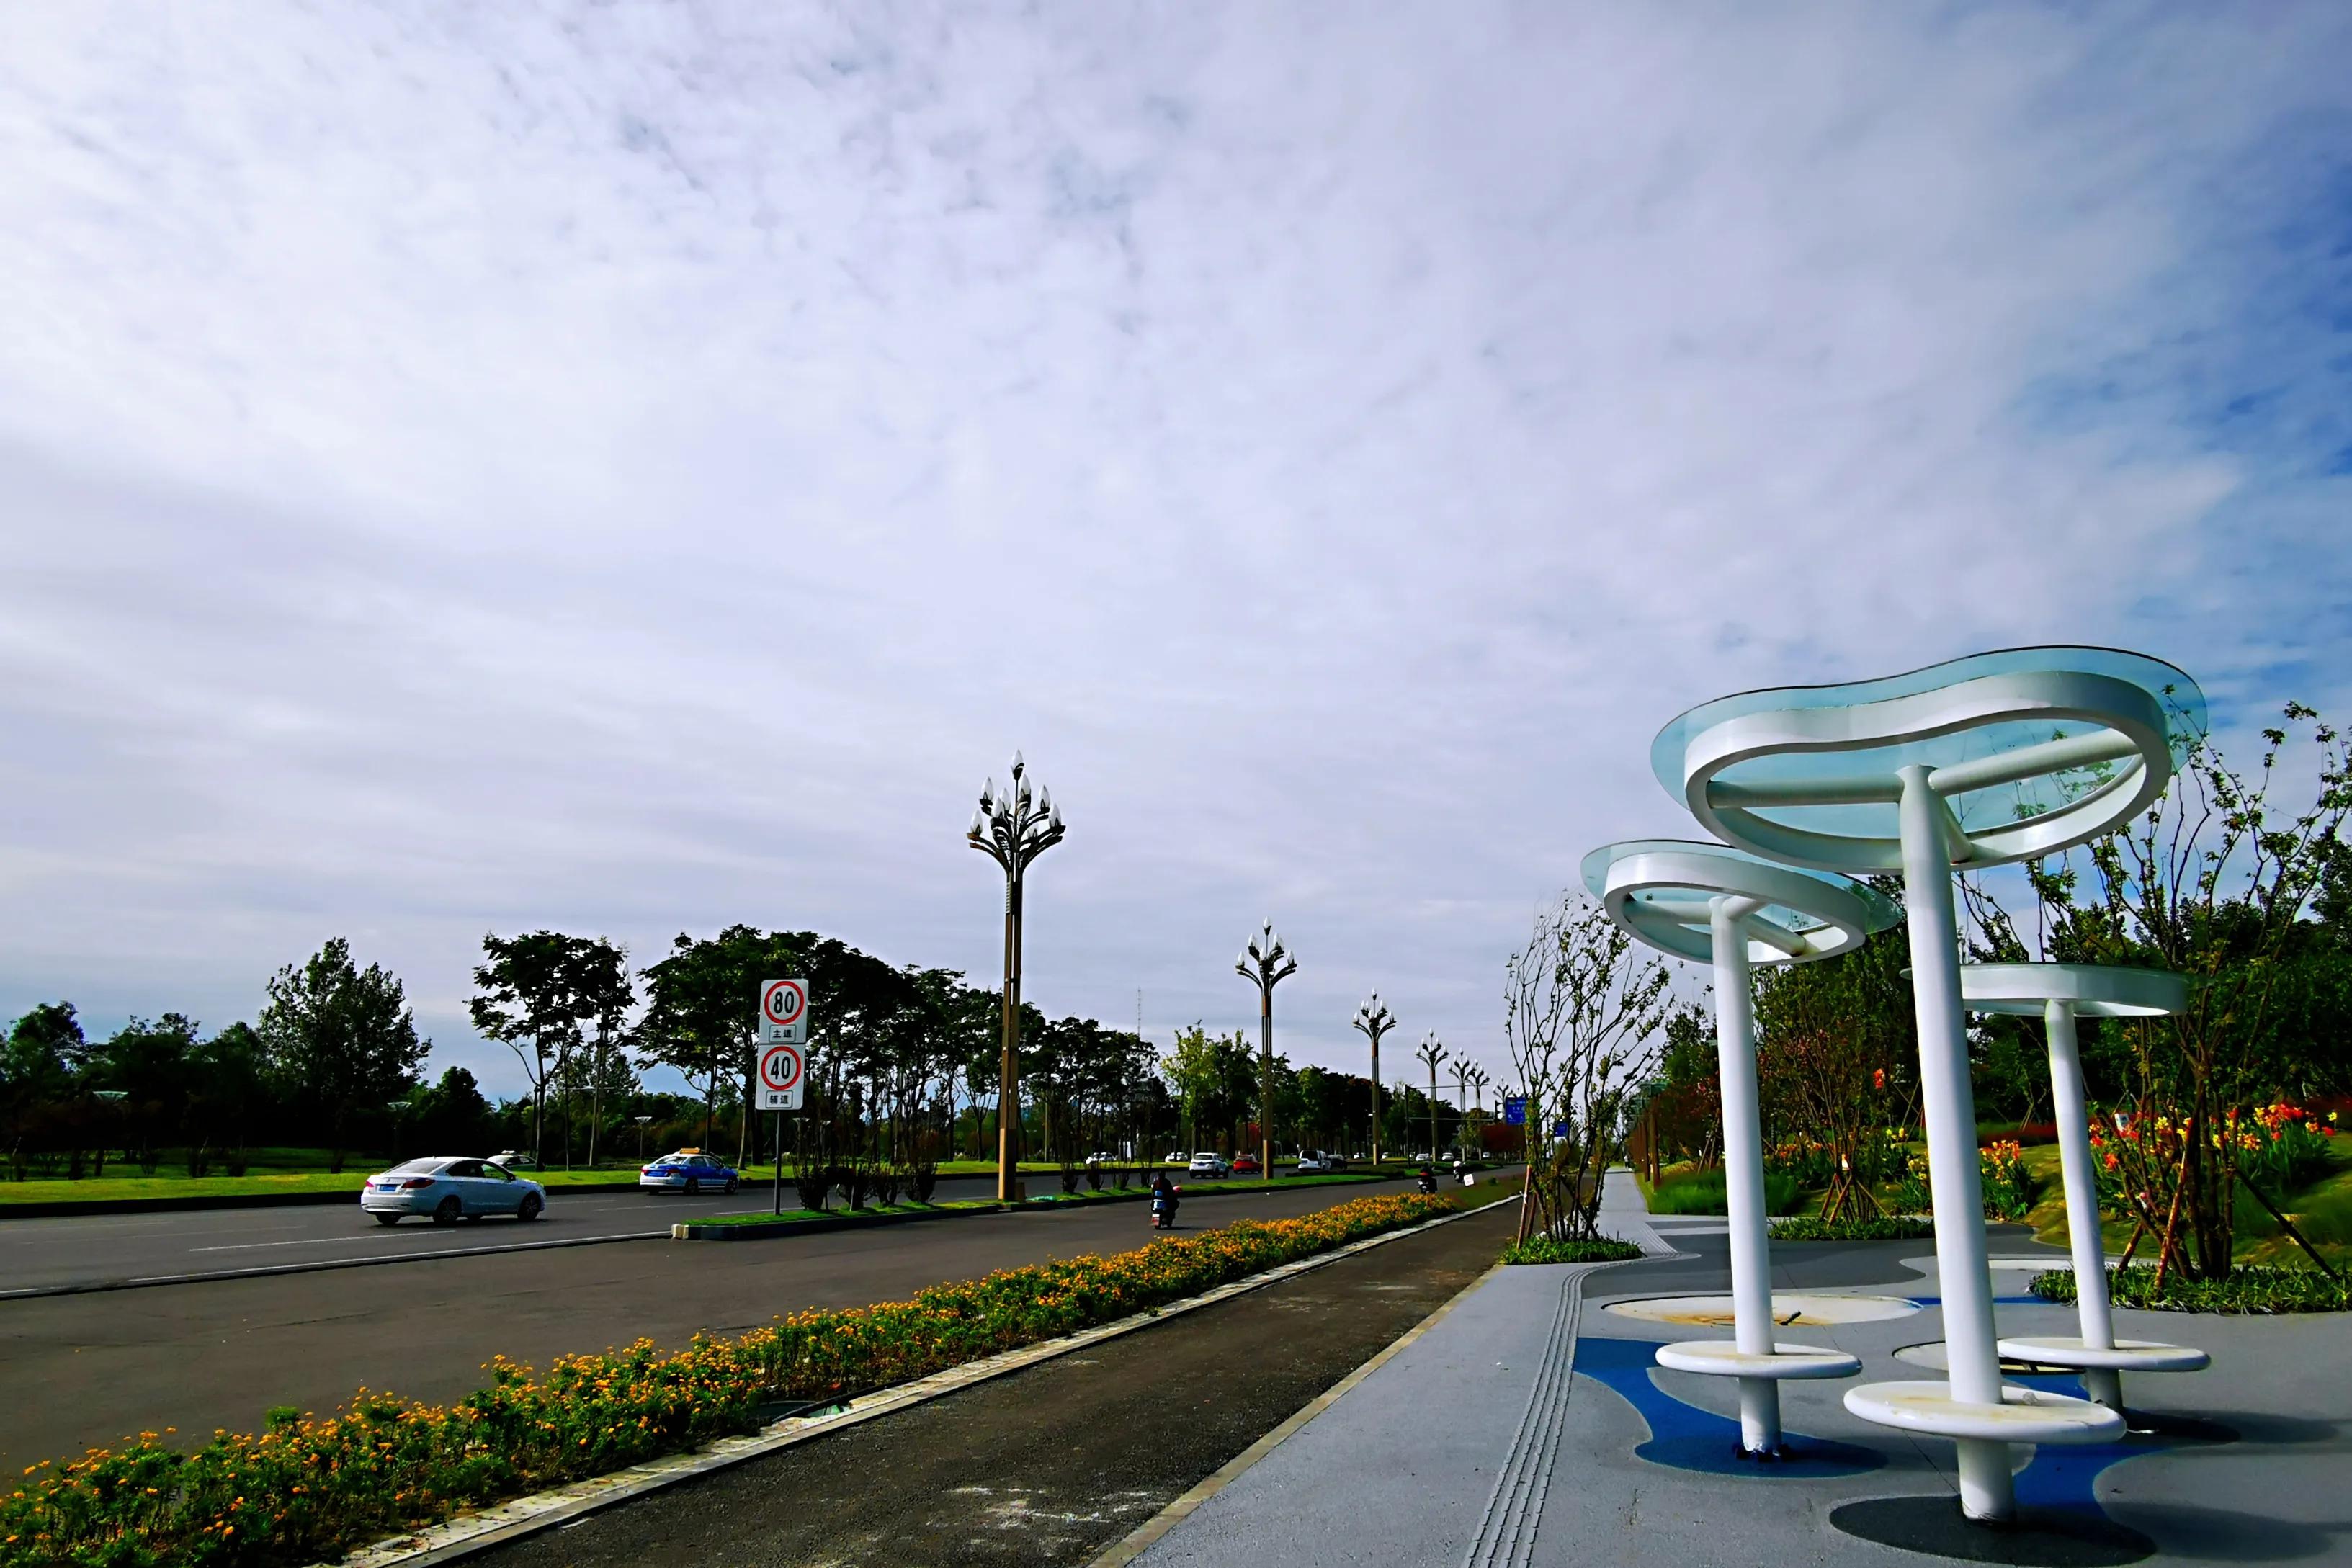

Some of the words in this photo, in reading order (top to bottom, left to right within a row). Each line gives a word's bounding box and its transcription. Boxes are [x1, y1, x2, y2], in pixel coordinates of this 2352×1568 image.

[774, 991, 795, 1014] 80
[772, 1029, 792, 1039] 主道
[771, 1056, 791, 1080] 40
